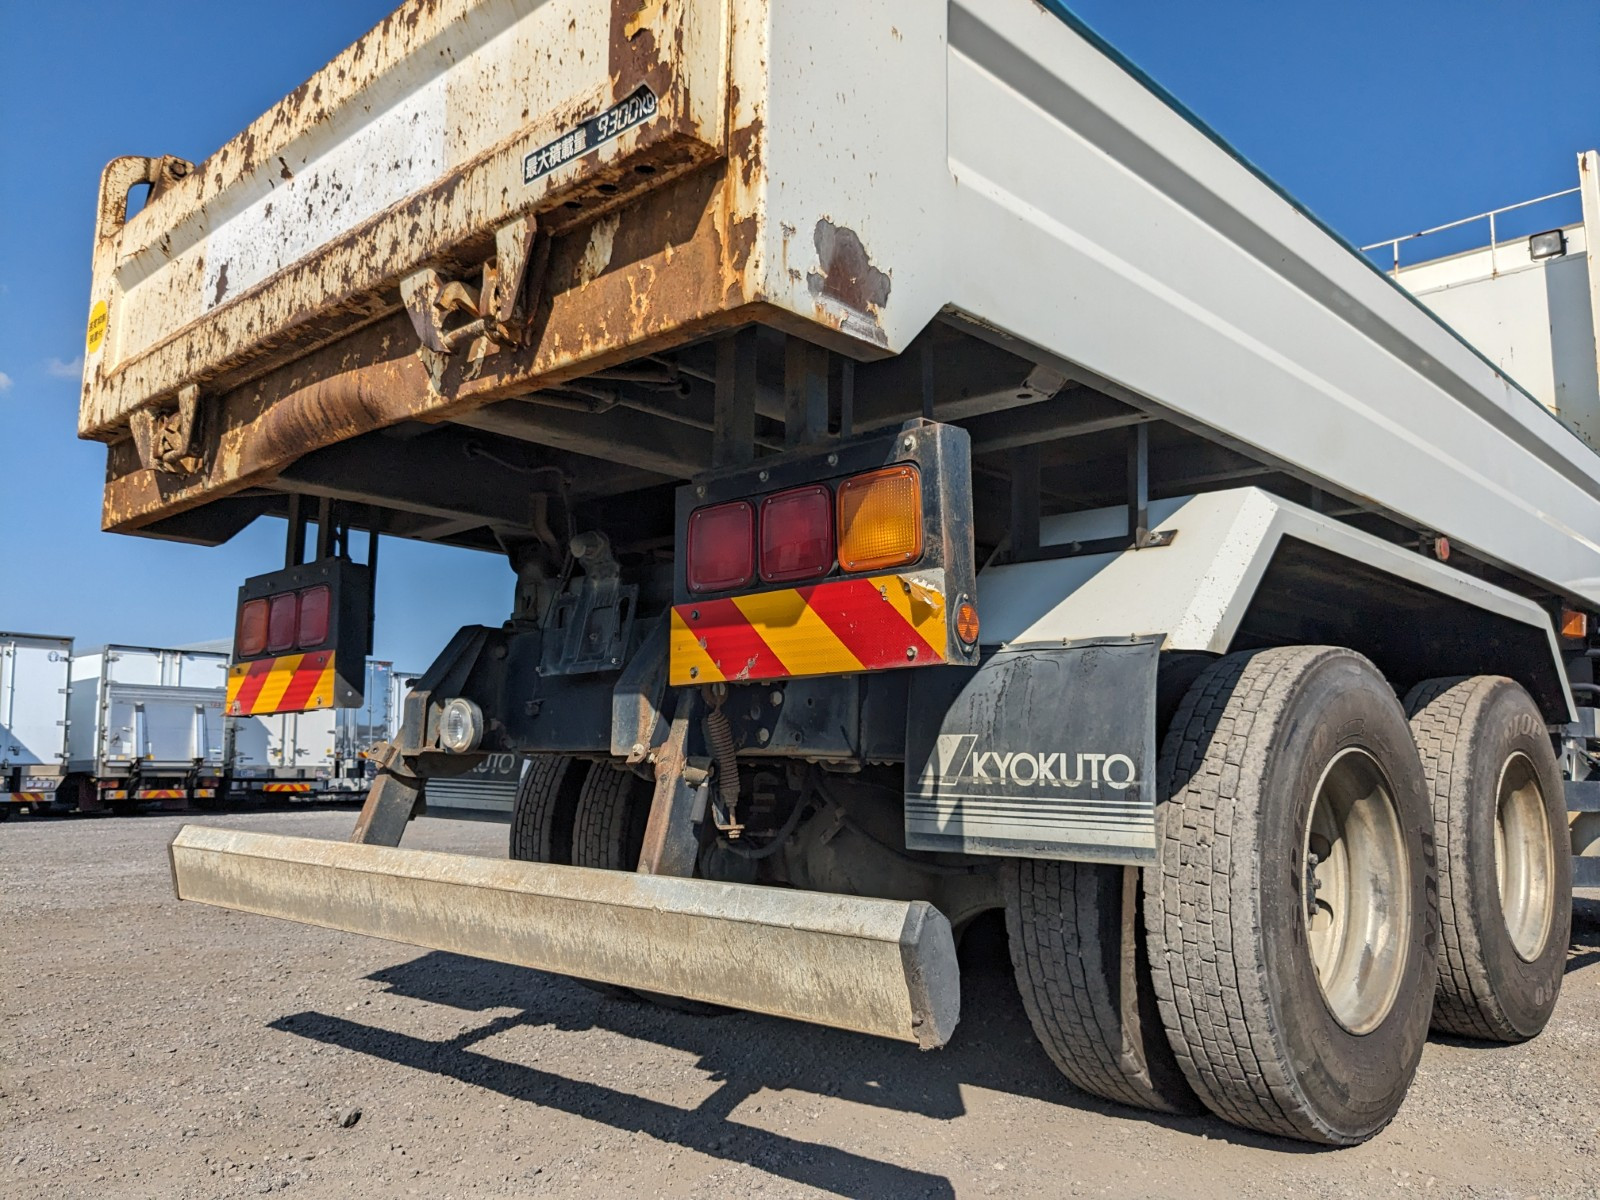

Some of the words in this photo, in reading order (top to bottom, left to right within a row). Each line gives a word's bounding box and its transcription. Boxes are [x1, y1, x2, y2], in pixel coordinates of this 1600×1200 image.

[525, 127, 587, 180] 最大積載量
[972, 751, 1136, 789] KYOKUTO
